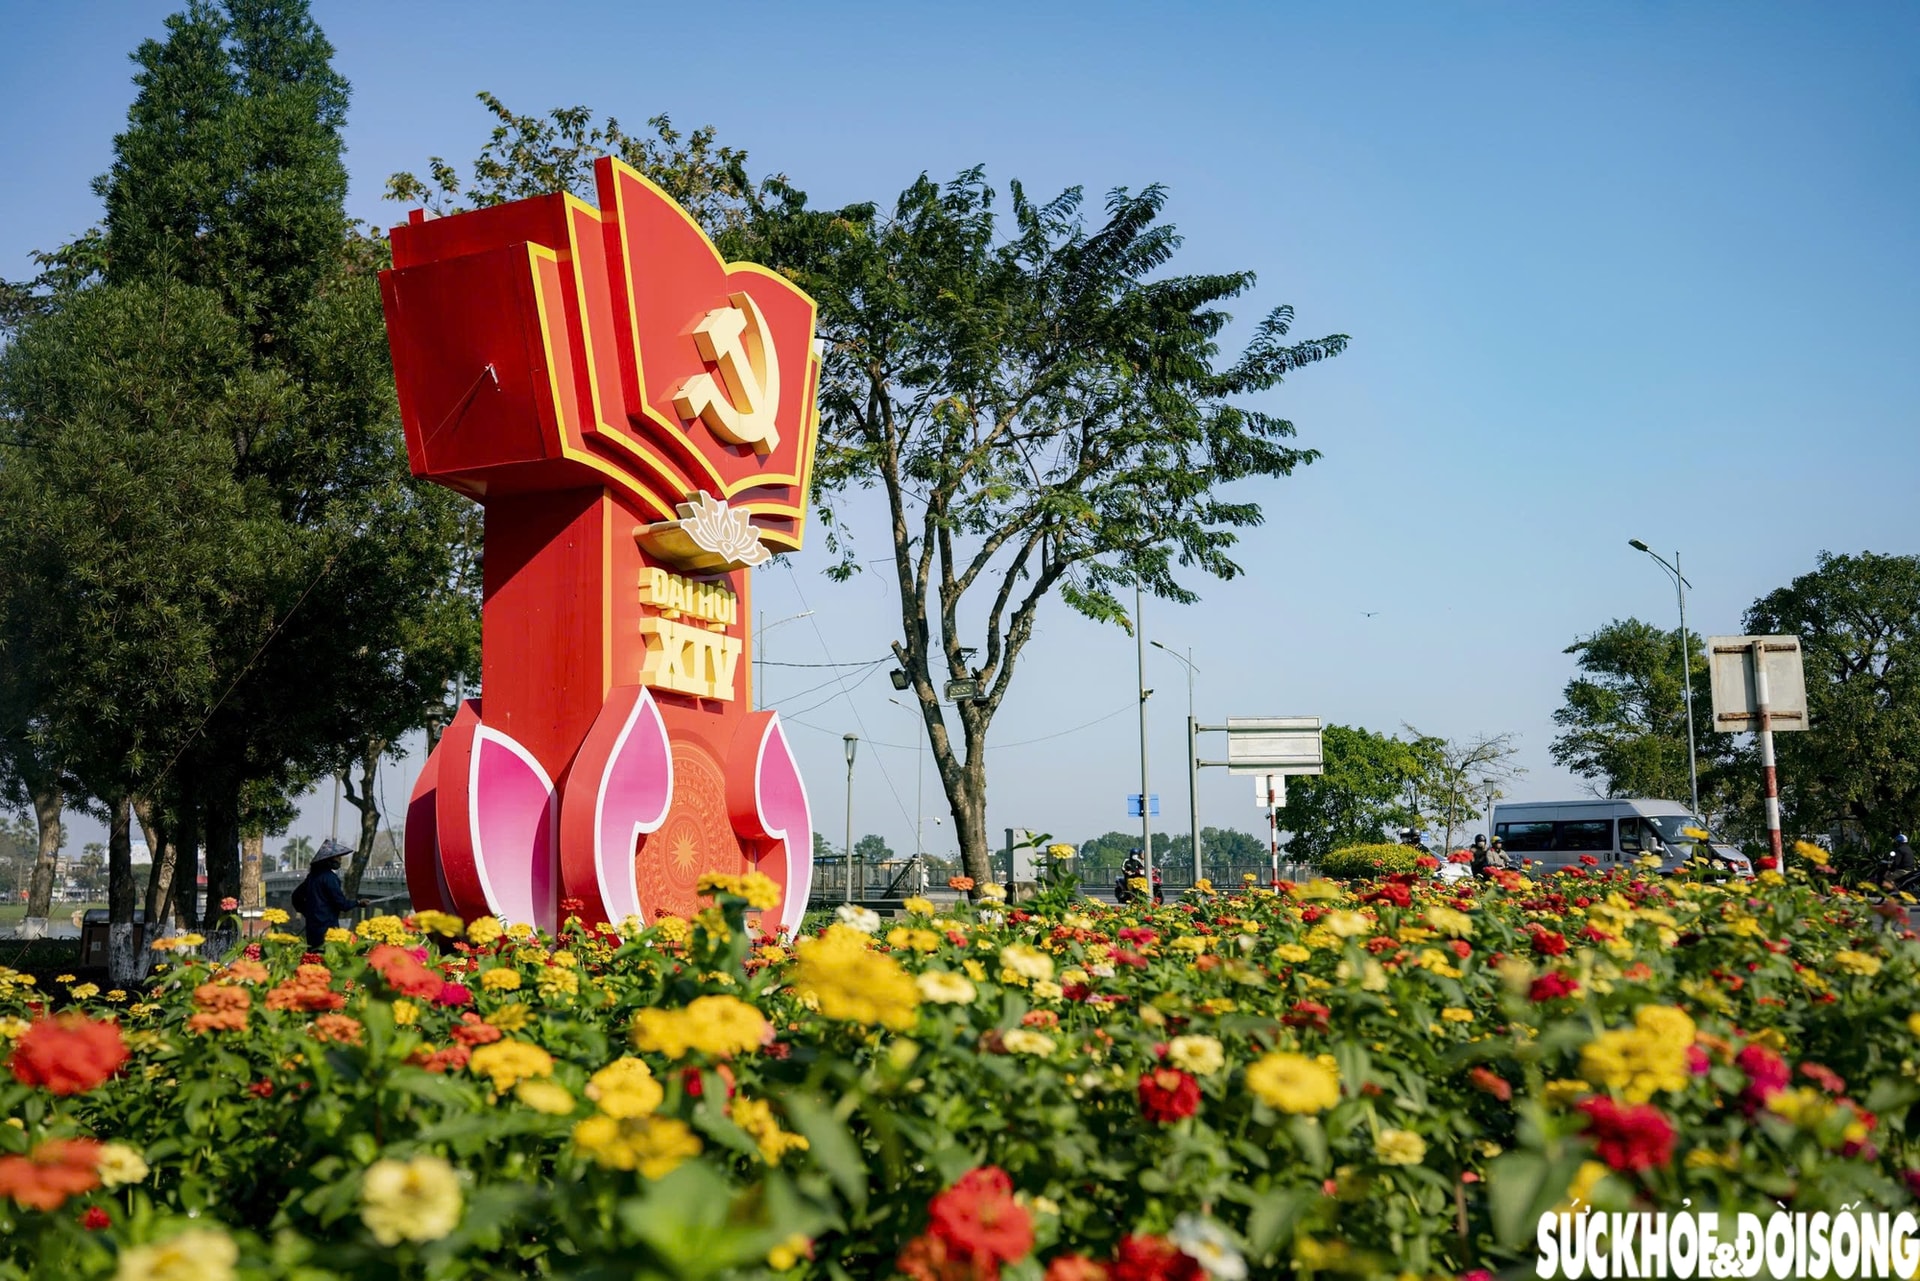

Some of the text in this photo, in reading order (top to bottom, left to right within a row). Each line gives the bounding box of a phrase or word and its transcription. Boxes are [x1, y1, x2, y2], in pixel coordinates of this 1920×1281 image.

[640, 567, 737, 632] ĐẠI HỘI
[640, 617, 742, 701] XIV
